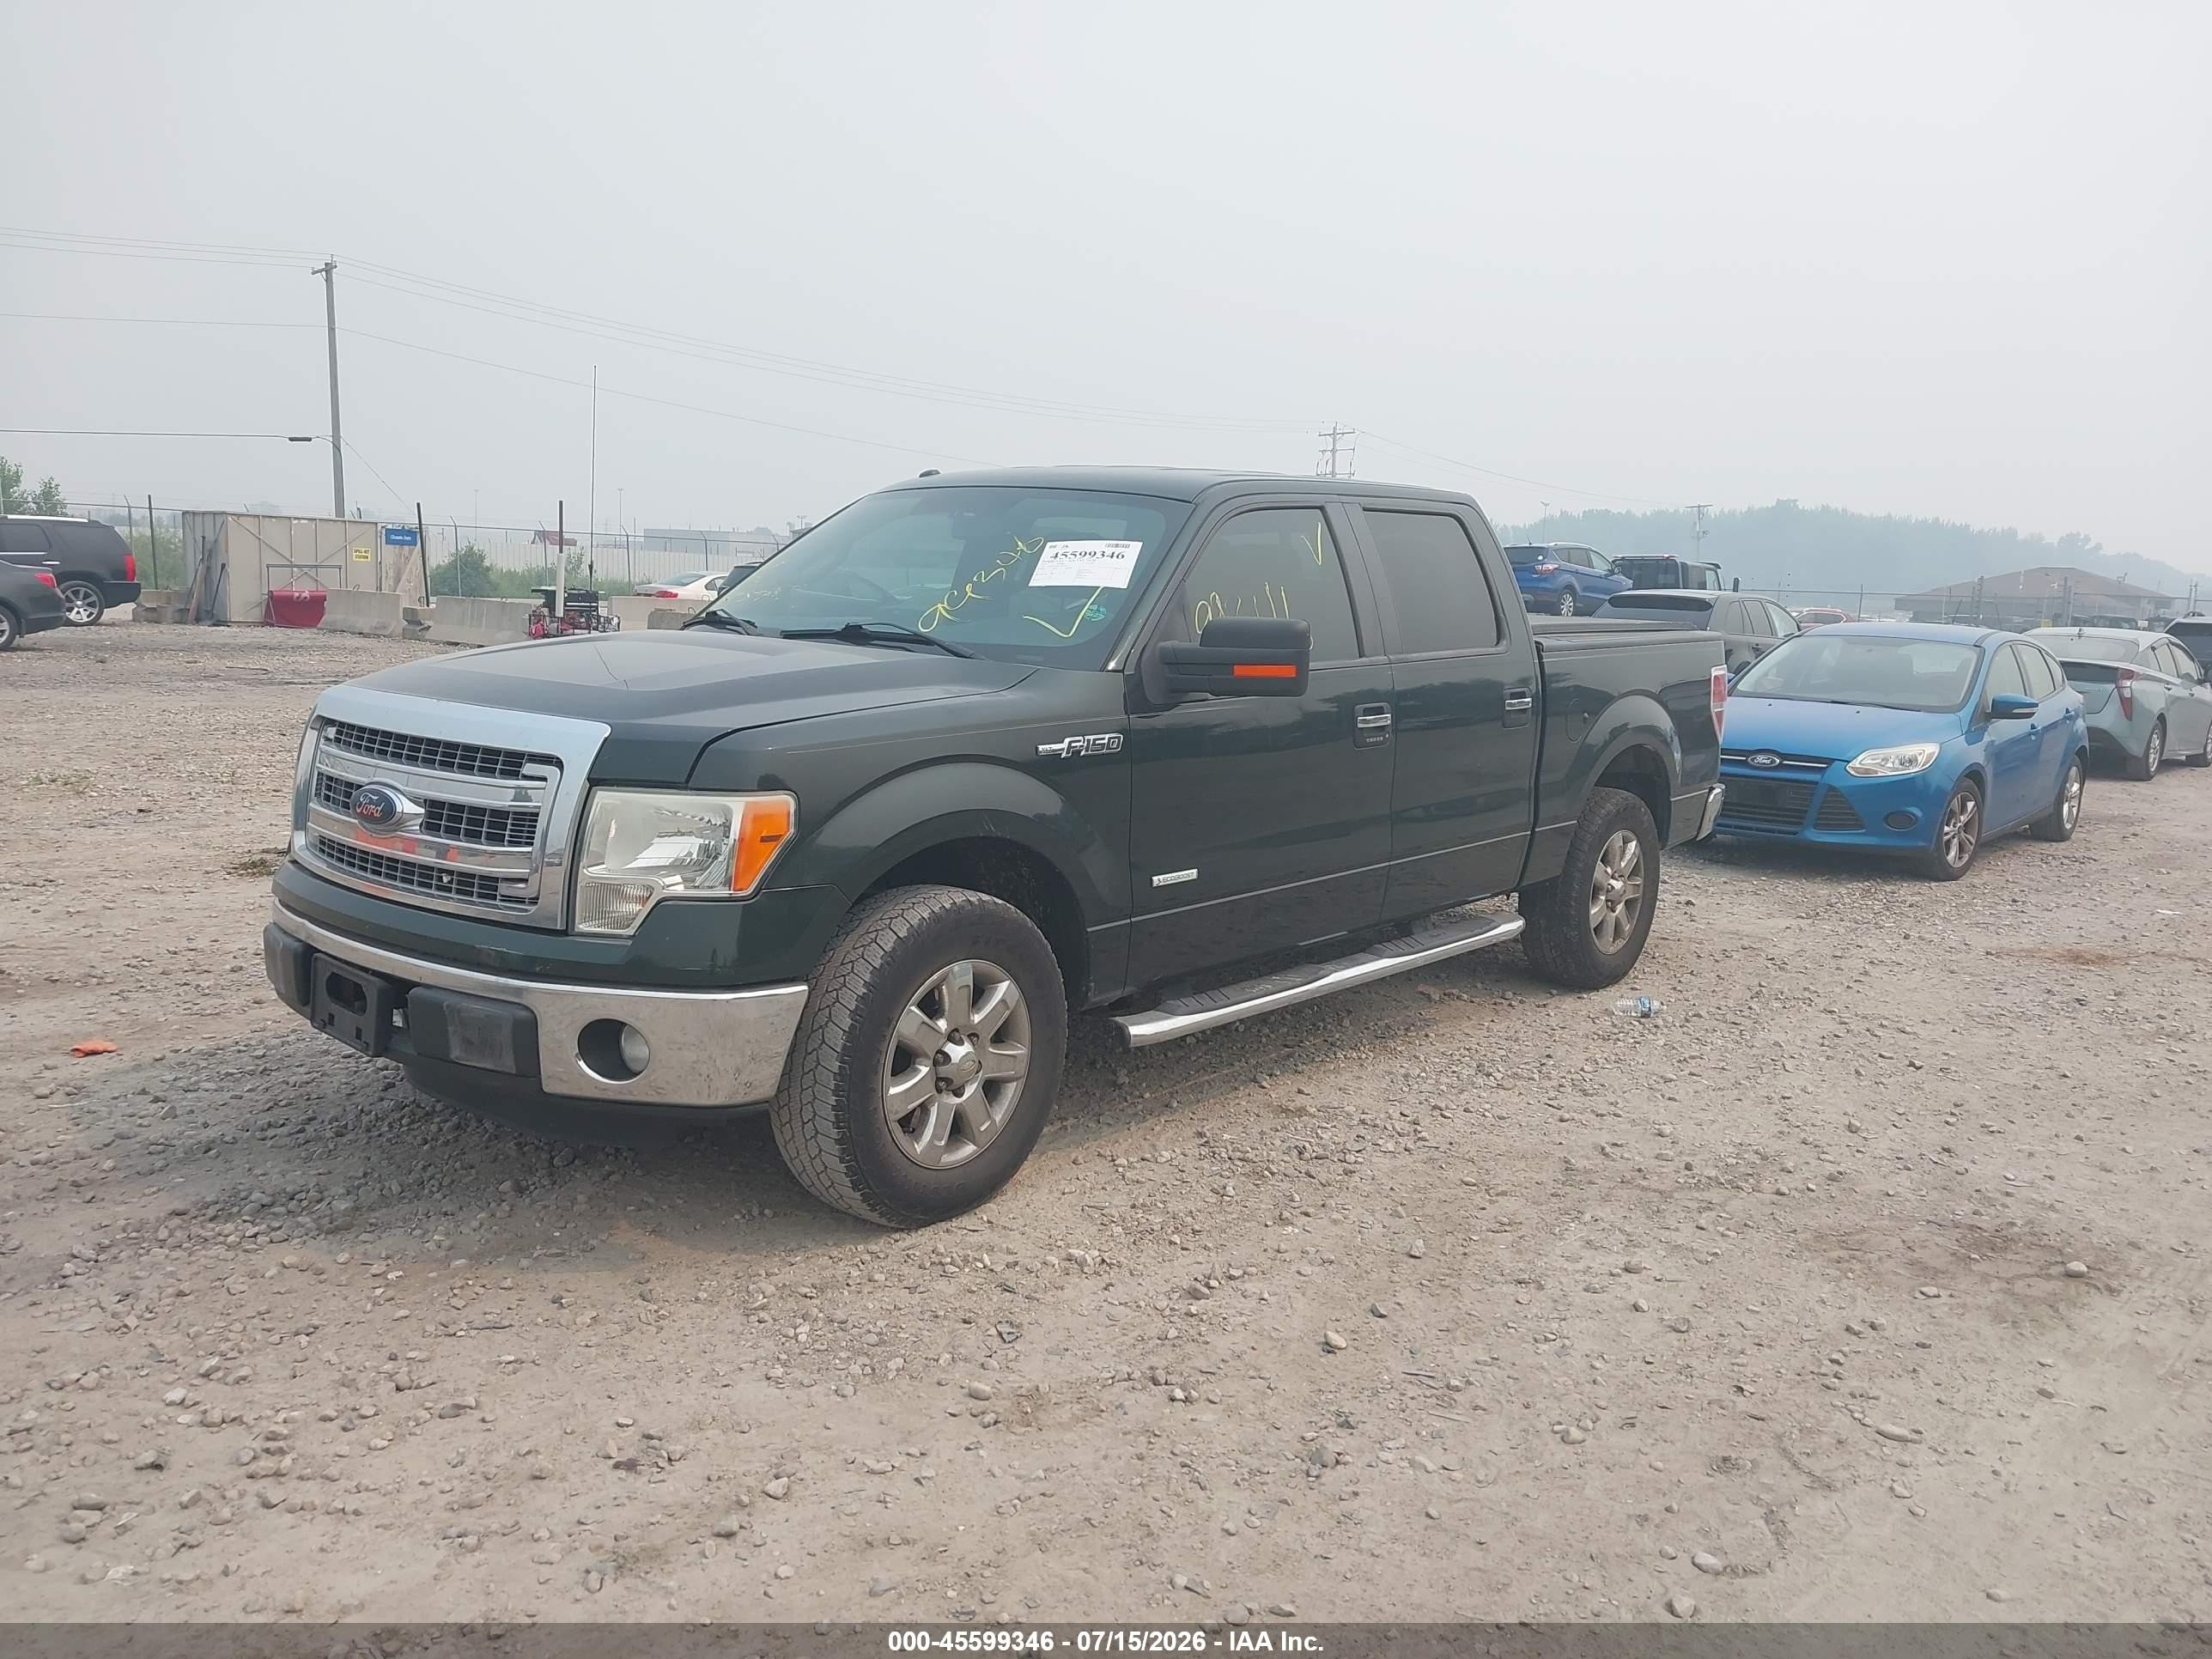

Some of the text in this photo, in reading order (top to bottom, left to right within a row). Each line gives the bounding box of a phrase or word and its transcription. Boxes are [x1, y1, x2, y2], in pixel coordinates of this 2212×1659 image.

[1048, 550, 1128, 560] 45599346
[1061, 732, 1123, 759] F-150
[356, 792, 386, 817] Ford
